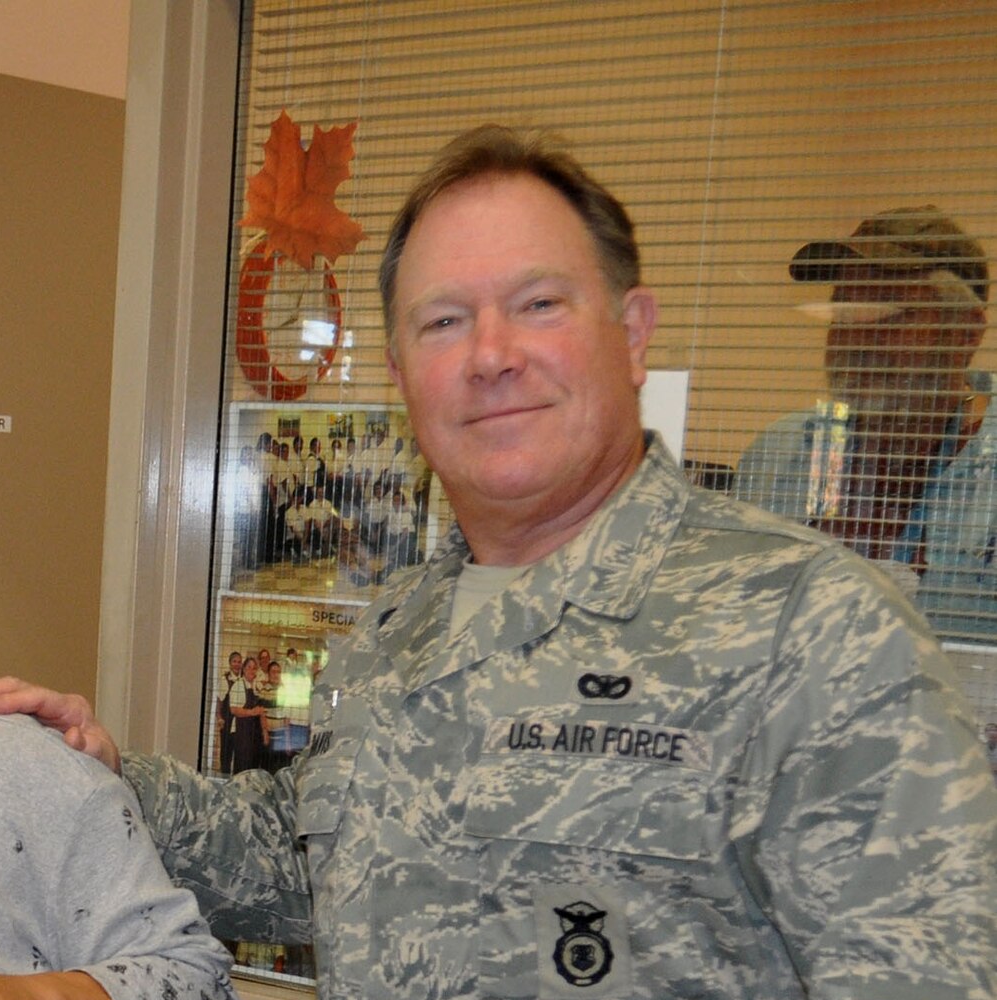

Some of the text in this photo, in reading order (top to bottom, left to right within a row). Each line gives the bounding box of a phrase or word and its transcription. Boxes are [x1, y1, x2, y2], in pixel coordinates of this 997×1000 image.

[312, 610, 356, 626] SPECIA
[508, 723, 688, 762] U.S. AIR FORCE
